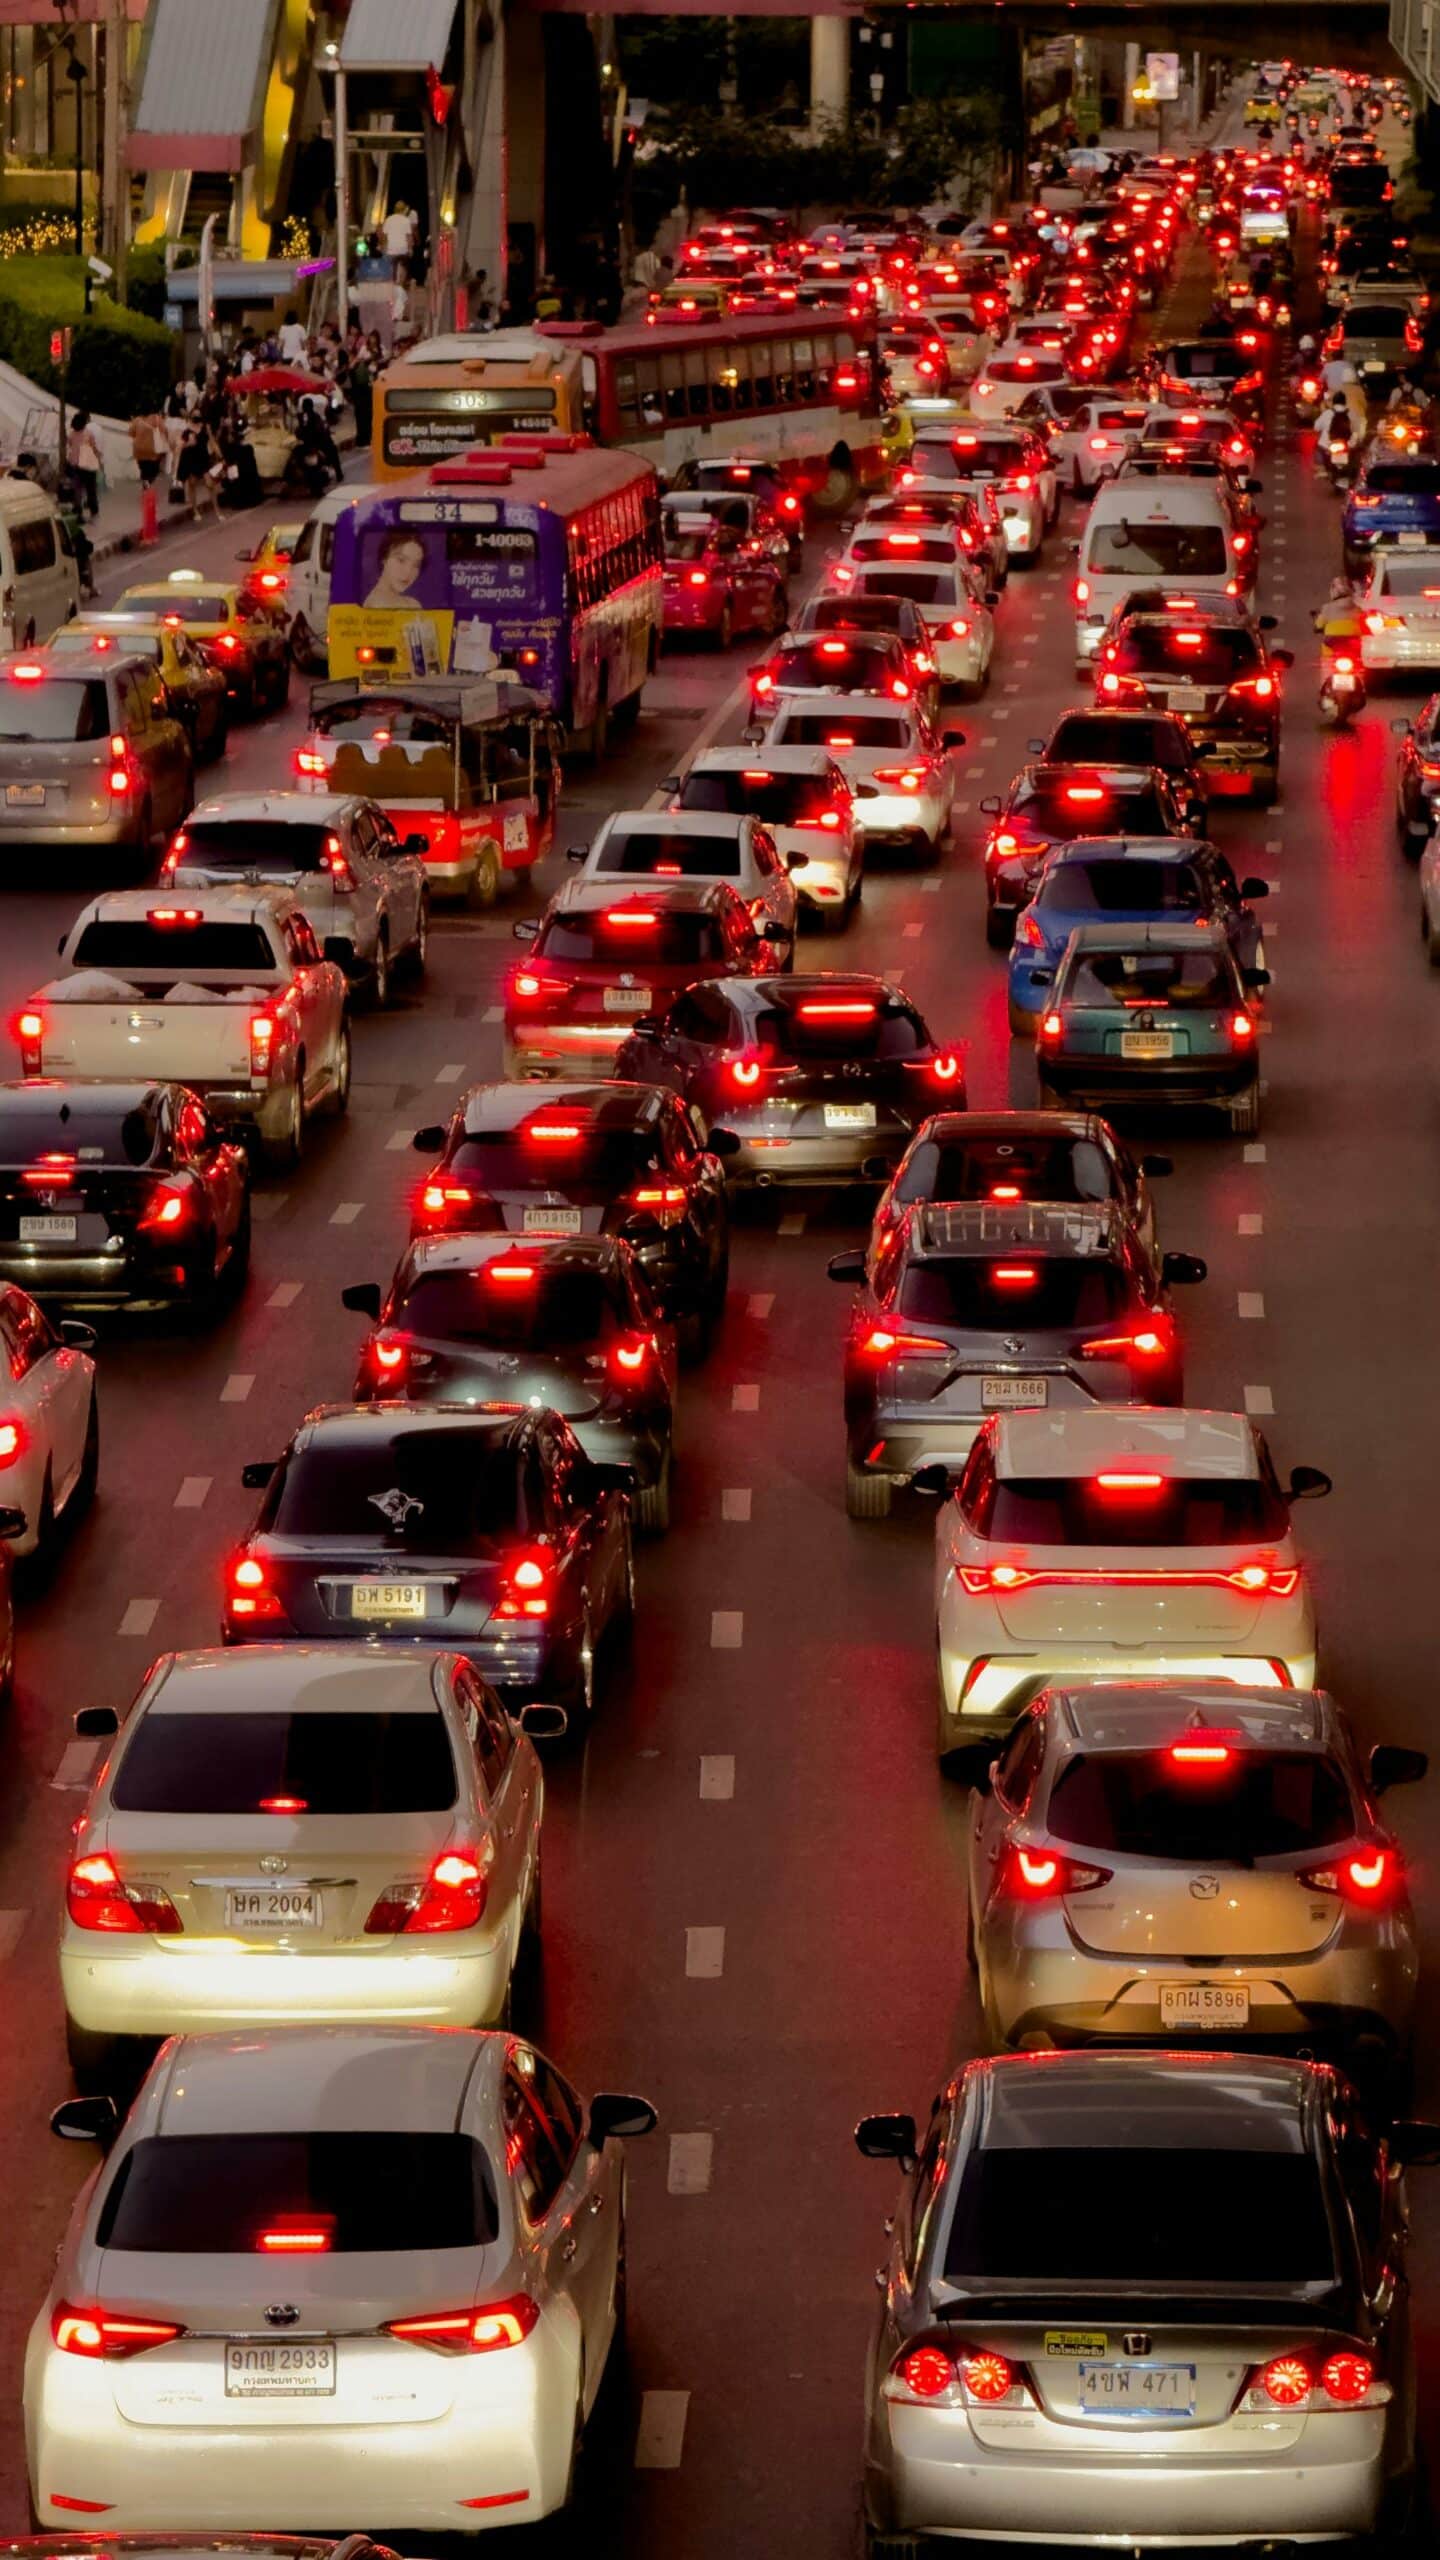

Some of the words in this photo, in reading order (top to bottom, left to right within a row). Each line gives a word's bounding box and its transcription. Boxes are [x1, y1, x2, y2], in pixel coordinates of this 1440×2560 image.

[452, 392, 487, 407] 503
[433, 503, 463, 521] 34
[1016, 1382, 1044, 1394] 1666
[384, 1587, 421, 1603] 5191
[269, 1895, 313, 1913] 2004
[1204, 1991, 1244, 2007] 5896
[231, 2349, 276, 2372] 9กญ
[279, 2349, 330, 2370] 2933
[1143, 2372, 1177, 2392] 471
